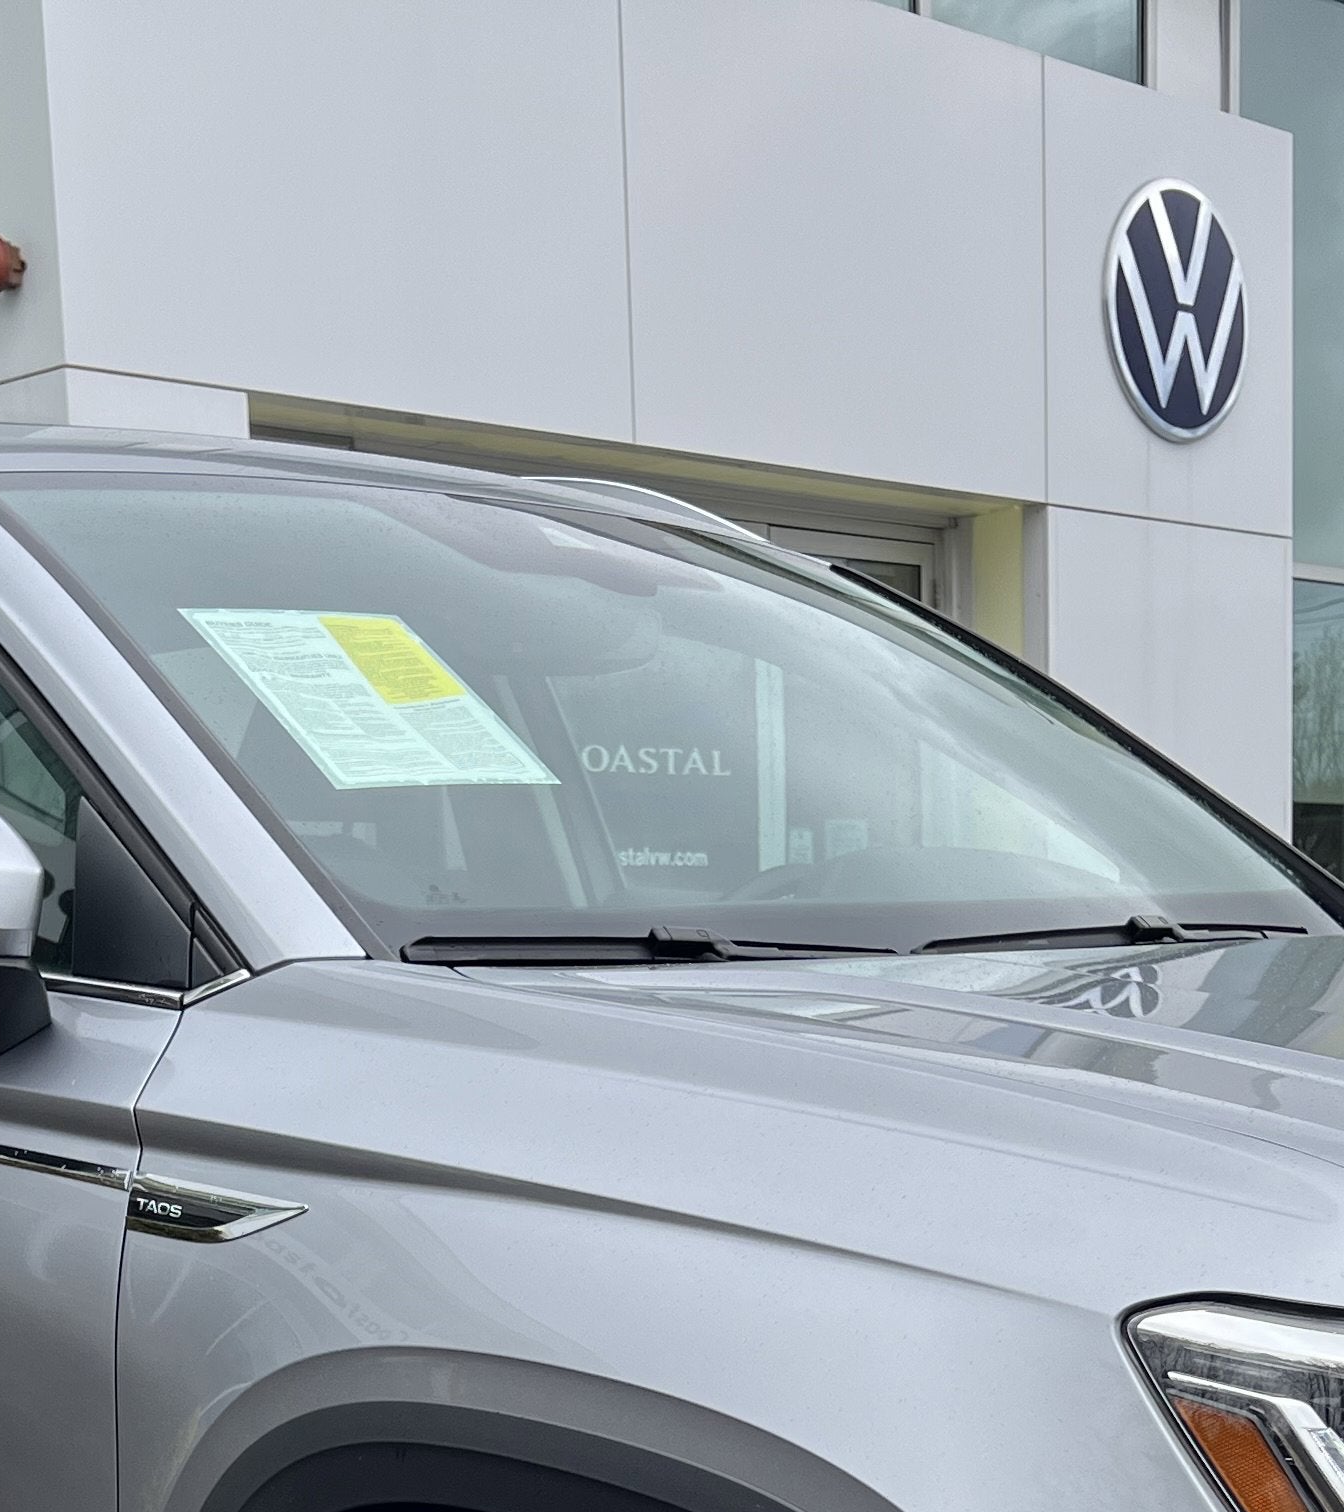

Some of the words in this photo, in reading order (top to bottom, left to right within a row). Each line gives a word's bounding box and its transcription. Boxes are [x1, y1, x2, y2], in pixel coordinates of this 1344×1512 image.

[1105, 178, 1248, 443] VW
[581, 744, 731, 777] OASTAL
[617, 847, 709, 868] stalvw.com
[136, 1197, 183, 1219] TAOS
